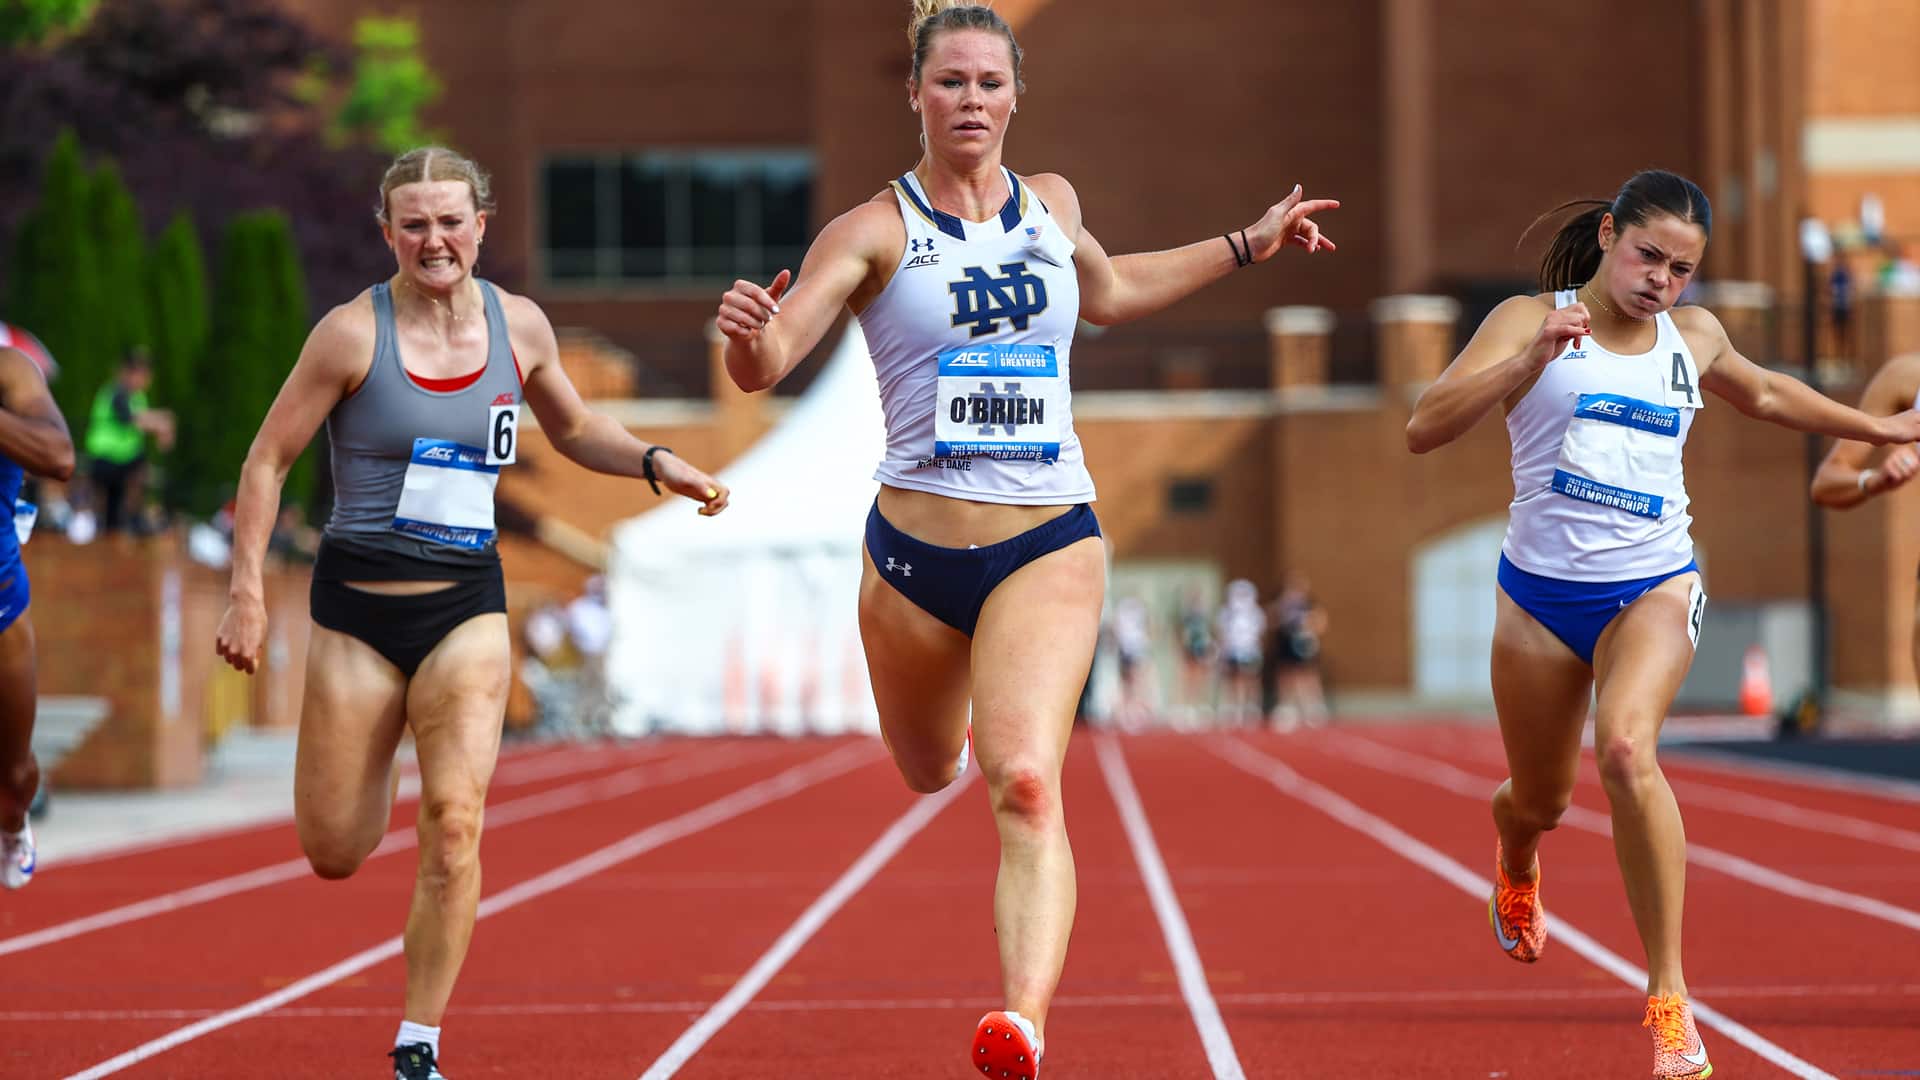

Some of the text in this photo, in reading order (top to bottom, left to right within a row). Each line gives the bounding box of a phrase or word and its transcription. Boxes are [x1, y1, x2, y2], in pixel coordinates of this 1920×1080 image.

[904, 253, 940, 270] ACC
[948, 352, 991, 367] ACC
[1000, 358, 1047, 368] GREATNESS
[1563, 351, 1588, 360] ACC
[1671, 352, 1694, 404] 4
[950, 396, 1045, 425] O'BRIEN
[1584, 400, 1627, 417] ACC
[1631, 411, 1673, 428] GREATNESS
[494, 410, 514, 460] 6
[420, 446, 455, 461] ACC
[946, 459, 972, 471] DAME
[1582, 481, 1593, 490] ACC
[1564, 483, 1650, 514] CHAMPIONSHIPS
[1692, 592, 1703, 644] 4
